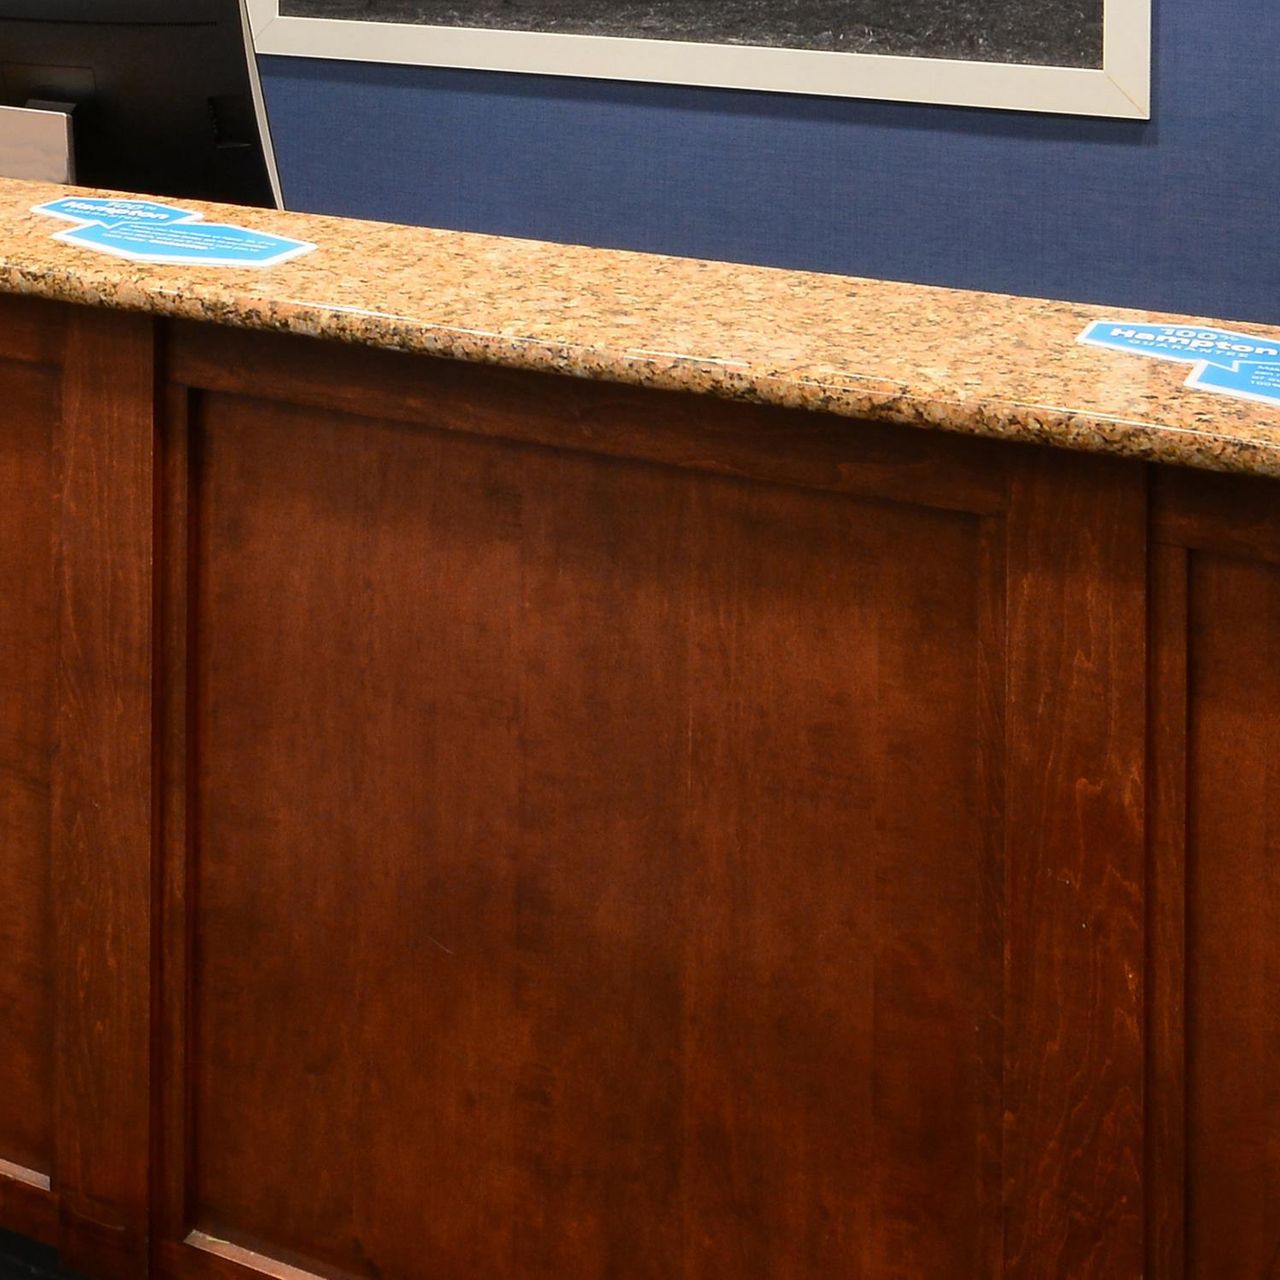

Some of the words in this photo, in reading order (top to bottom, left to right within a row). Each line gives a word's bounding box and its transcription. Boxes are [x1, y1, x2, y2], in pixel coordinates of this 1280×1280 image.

[60, 201, 170, 220] Hampton
[1110, 327, 1280, 356] Hampton
[1160, 327, 1239, 341] 100%
[1127, 339, 1249, 358] GUARANTEE
